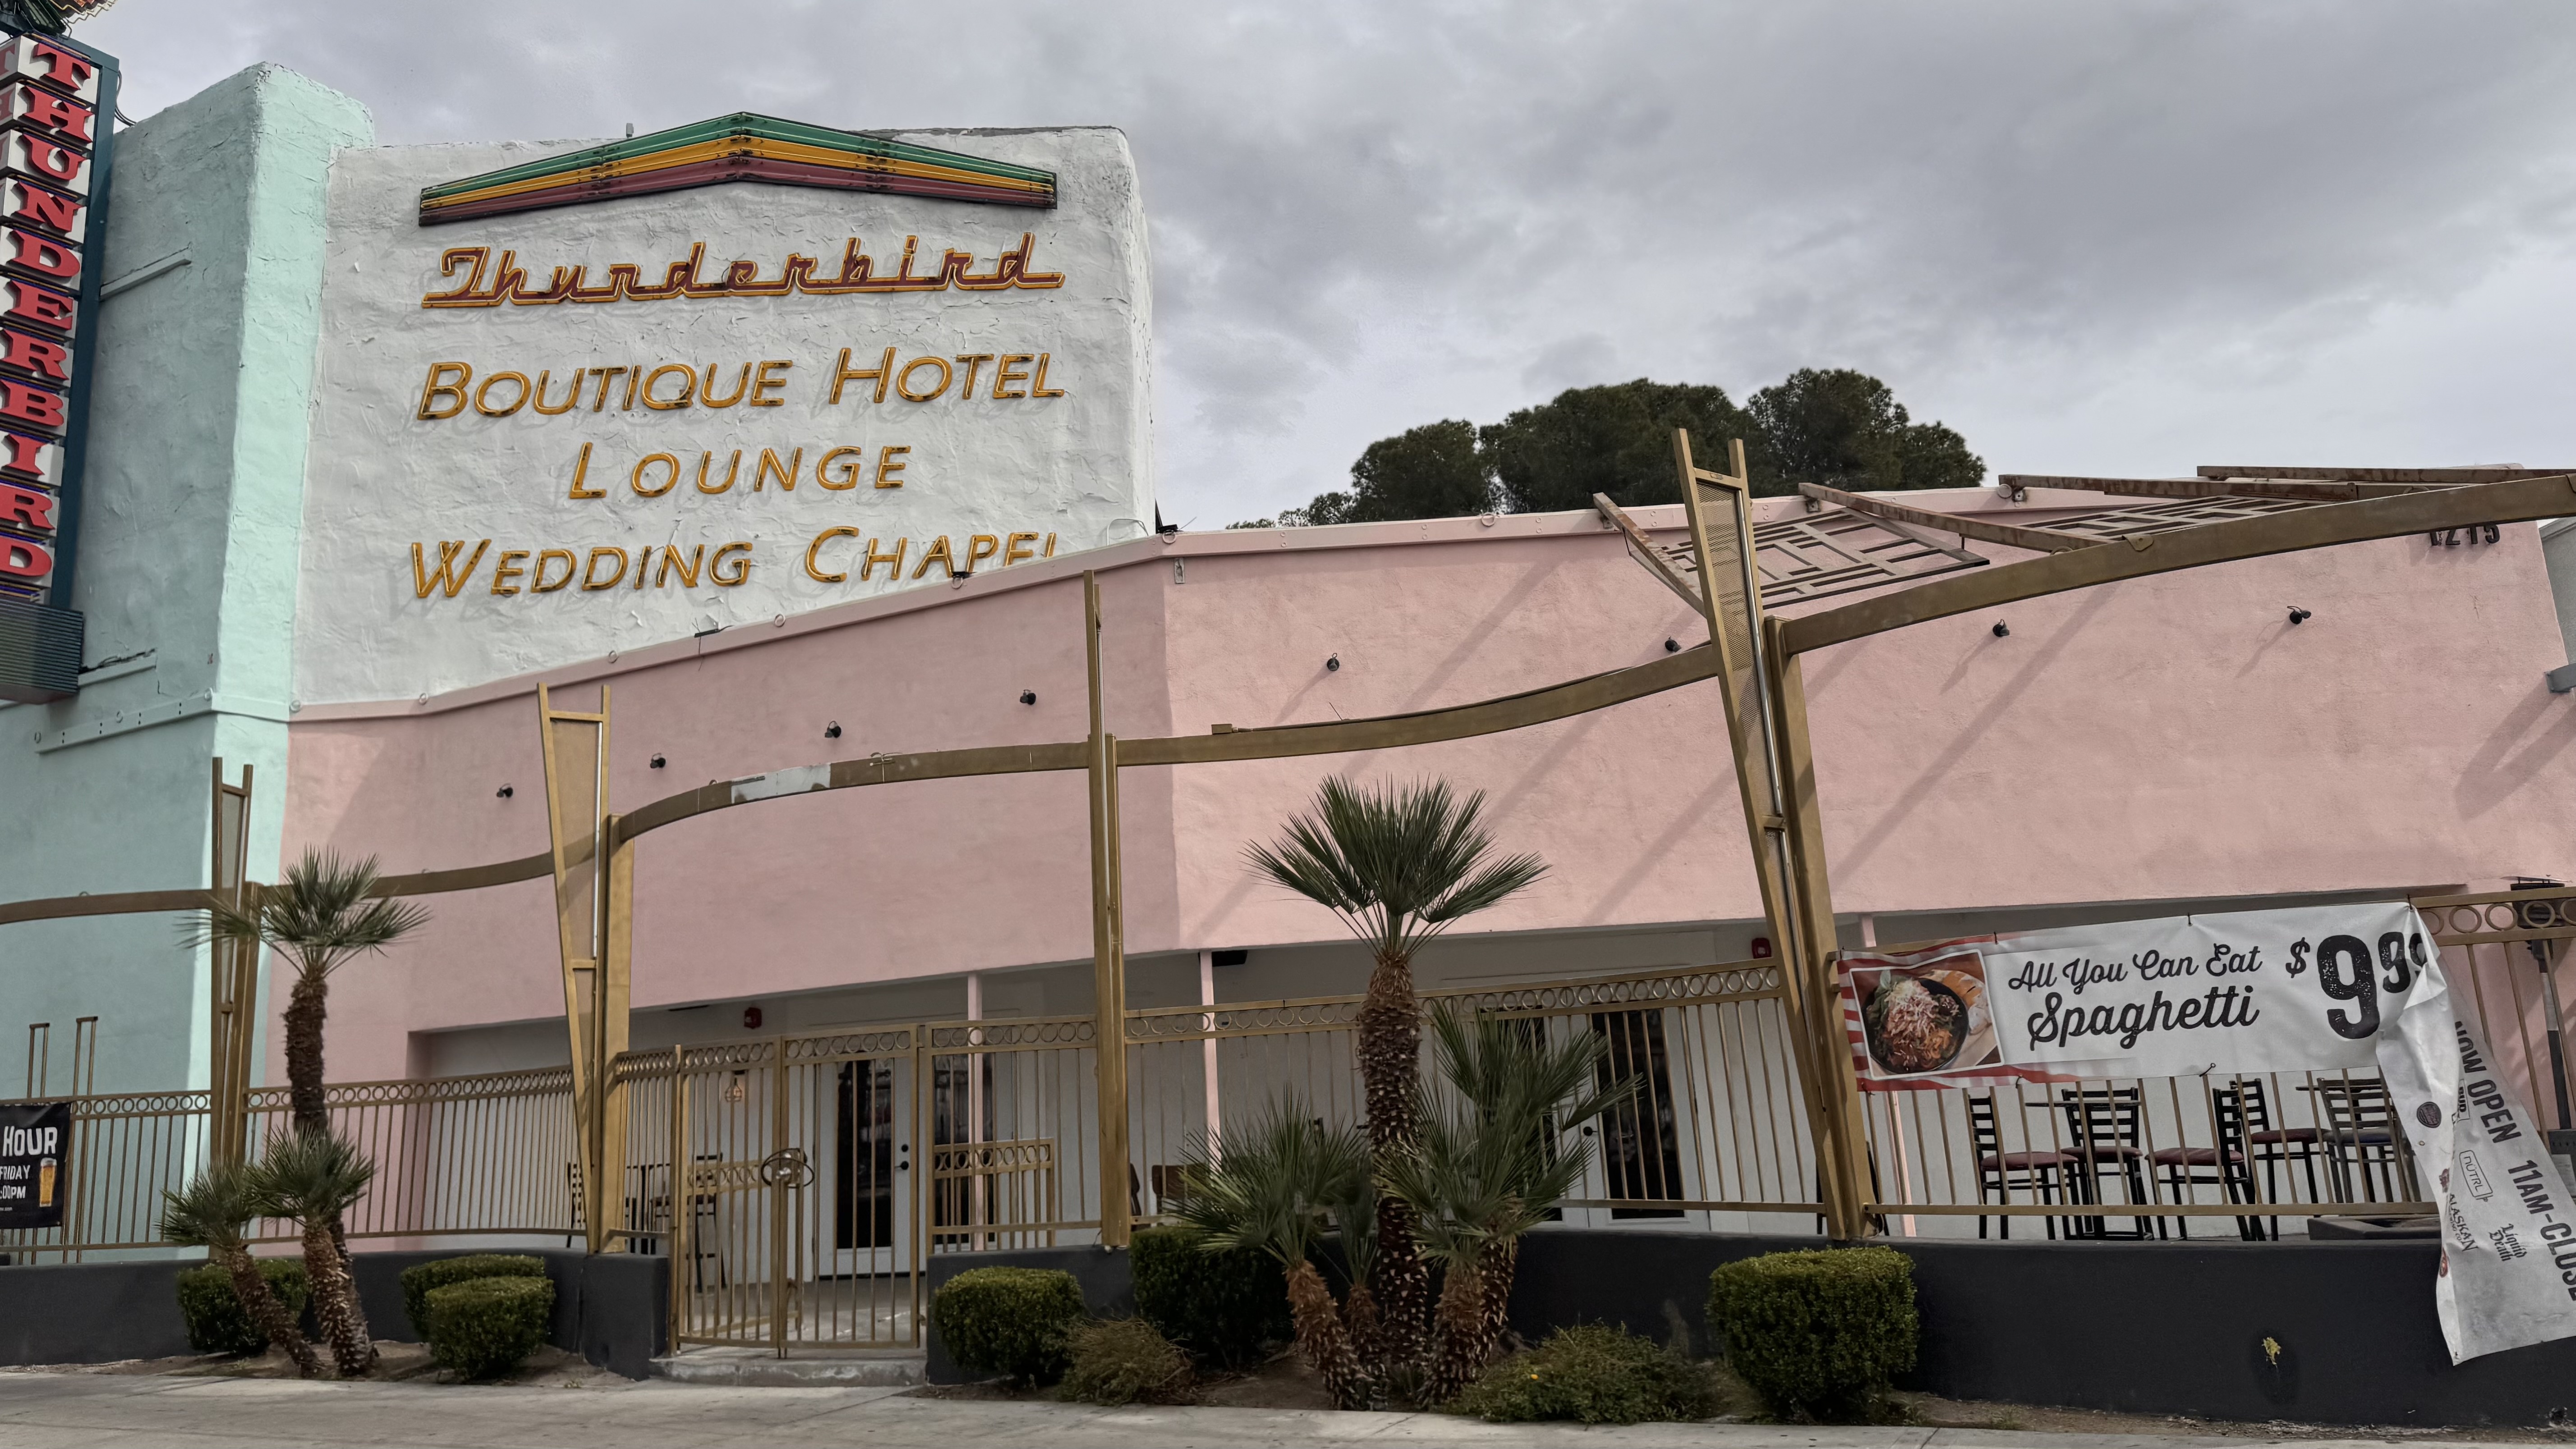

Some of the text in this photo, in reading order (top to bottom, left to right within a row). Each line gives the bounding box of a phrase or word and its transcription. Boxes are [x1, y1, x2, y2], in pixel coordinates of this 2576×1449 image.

[421, 232, 1065, 308] Thunderbird
[0, 42, 94, 576] THUNDERBIRD
[417, 347, 1065, 420] BOUTIQUE HOTEL
[569, 442, 911, 499] LOUNGE
[411, 539, 753, 598] WEDDING
[2008, 943, 2263, 994] All You Can Eat
[2028, 985, 2260, 1051] Spaghetti
[2467, 1080, 2522, 1143] OPEN
[2, 1126, 58, 1157] HOUR
[2450, 1193, 2479, 1252] ALASKAN
[2488, 1229, 2514, 1261] Death
[2500, 1223, 2527, 1258] Liquid
